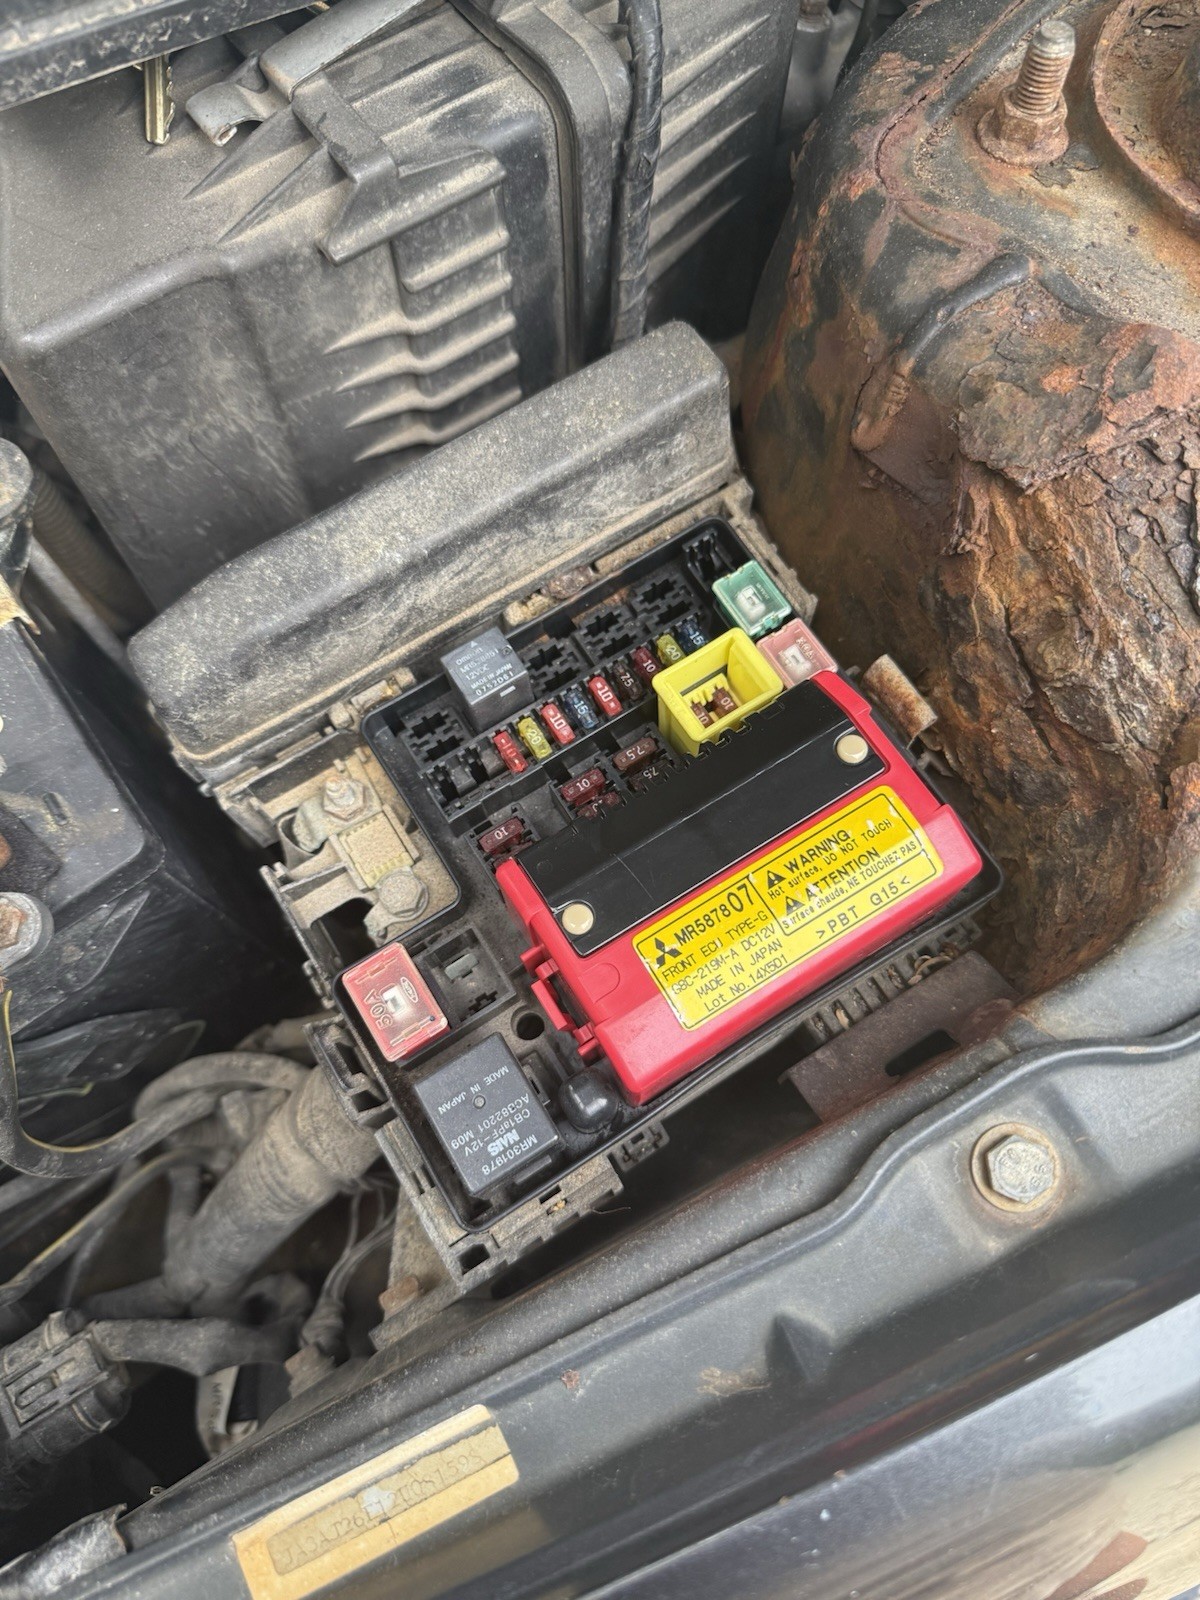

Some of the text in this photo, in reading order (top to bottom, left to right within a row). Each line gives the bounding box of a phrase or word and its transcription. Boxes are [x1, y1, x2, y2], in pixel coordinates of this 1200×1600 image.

[689, 631, 704, 645] 15
[666, 646, 680, 661] 20
[642, 659, 656, 673] 10
[620, 673, 634, 687] 7.5
[598, 687, 613, 702] 10
[720, 697, 734, 710] 10
[574, 701, 588, 715] 15
[550, 715, 565, 730] 10
[527, 730, 542, 745] 20
[626, 745, 645, 761] 7.5
[642, 766, 659, 779] 7.5
[575, 778, 591, 791] 10
[494, 826, 509, 840] 10
[767, 885, 785, 900] Hot
[823, 853, 838, 865] DO
[840, 839, 860, 856] NOT
[861, 818, 893, 841] TOUCH
[783, 829, 851, 874] WARNING
[848, 876, 860, 889] NE
[859, 851, 901, 881] TOUCHEZ
[899, 840, 917, 857] PAS
[805, 847, 881, 901] ATTENTION
[674, 883, 754, 947] MR587807
[662, 910, 768, 981] FRONT ECU TYPE-G
[740, 923, 775, 952] DC12V
[695, 938, 783, 999] MADE IN JAPAN
[363, 988, 394, 1030] 50A
[704, 994, 727, 1012] Lot
[437, 1065, 509, 1115] MADE IN JAPAN
[451, 1129, 475, 1150] M09
[486, 1128, 520, 1156] NAIS
[481, 1134, 538, 1176] MR301978
